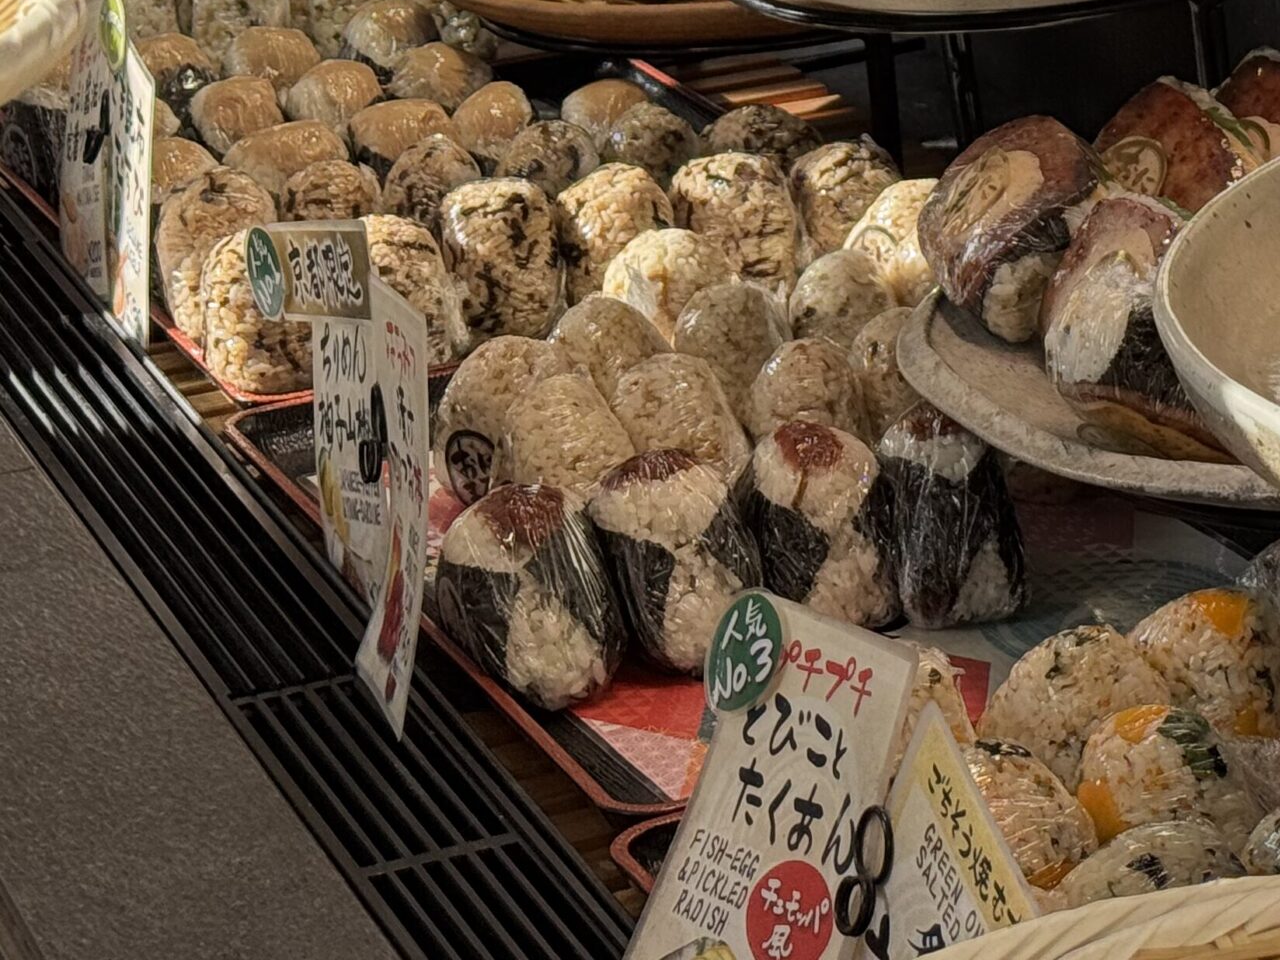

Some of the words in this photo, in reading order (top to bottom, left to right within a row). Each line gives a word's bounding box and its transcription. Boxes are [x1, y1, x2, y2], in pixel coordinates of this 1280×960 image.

[319, 321, 367, 385] ちりめん
[721, 598, 767, 650] 人気
[711, 638, 774, 708] No.3
[742, 692, 848, 780] とびこと
[731, 757, 856, 875] たくあん
[677, 856, 749, 911] &PICKLED
[689, 828, 760, 882] FISH-EGG
[924, 822, 964, 905] GREEN
[672, 889, 730, 937] RADISH
[760, 877, 831, 935] チュモッパ
[916, 845, 961, 942] SALTED
[762, 923, 792, 960] 風
